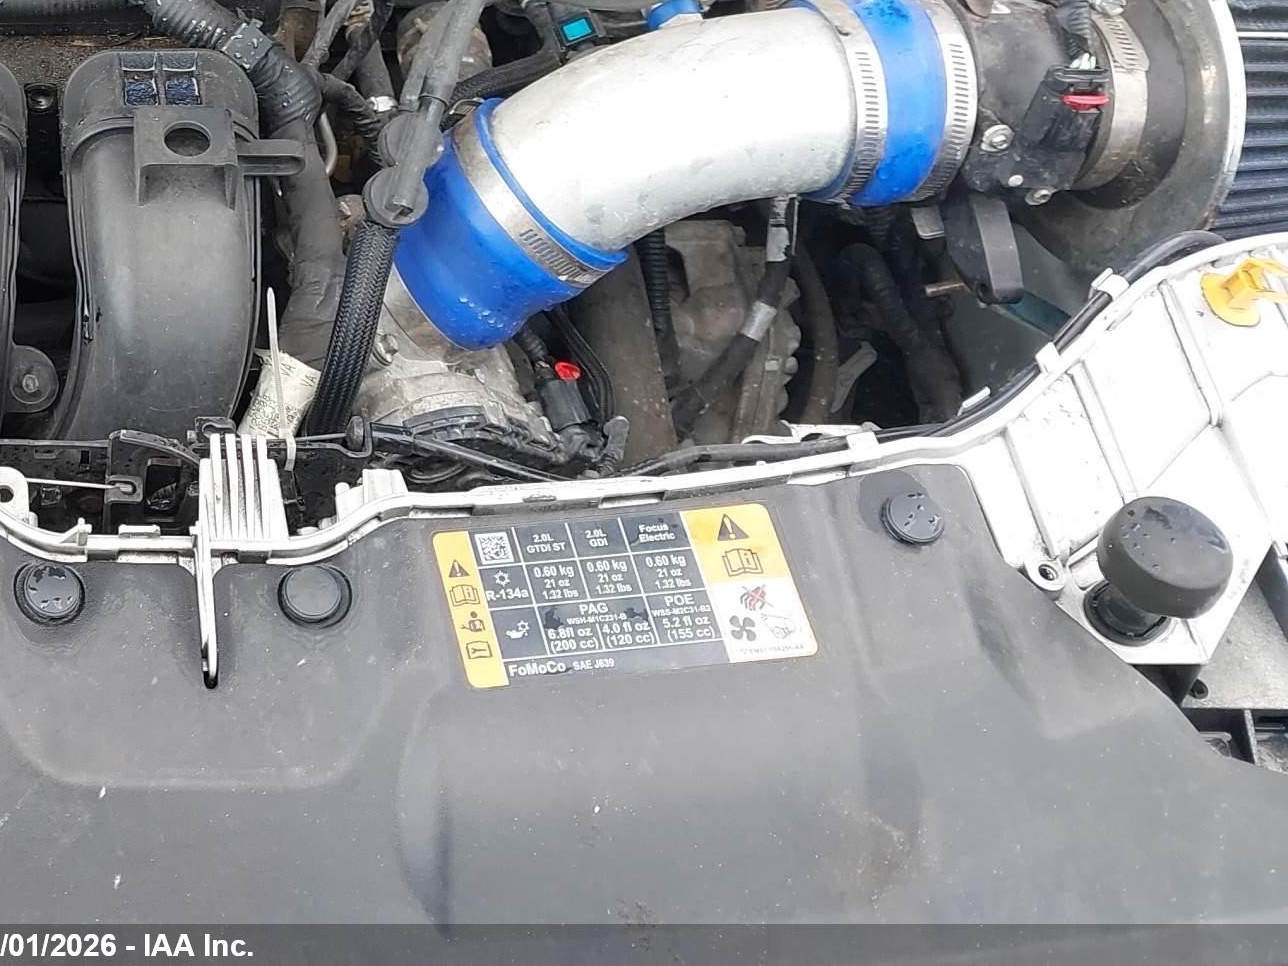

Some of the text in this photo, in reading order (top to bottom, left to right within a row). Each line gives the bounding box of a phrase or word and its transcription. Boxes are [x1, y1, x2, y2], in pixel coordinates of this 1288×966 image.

[585, 529, 606, 539] 2.0L
[638, 524, 669, 533] Focus
[532, 533, 555, 543] 2.0L
[589, 538, 609, 547] GDI
[638, 532, 676, 543] Electric
[527, 542, 566, 553] GTDI ST
[586, 559, 628, 572] 0.60 kg
[645, 554, 687, 568] 0.60 kg
[533, 564, 575, 578] 0.60 kg
[656, 568, 683, 578] 21 oz
[544, 579, 570, 588] 21 oz
[597, 573, 624, 583] 21 oz
[655, 578, 691, 589] 1.32 lbs
[485, 588, 529, 601] R-134a
[542, 588, 579, 600] 1.32 lbs
[596, 583, 632, 594] 1.32 lbs
[664, 594, 695, 606] POE
[579, 602, 609, 615] PAG
[602, 621, 650, 634] 4.0 fl oz
[662, 616, 710, 628] 5.2 fl oz
[577, 627, 593, 637] oz
[667, 626, 715, 642] (155 cc)
[550, 637, 599, 654] (200 cc)
[606, 632, 655, 648] (120 cc)
[508, 658, 615, 677] FoMoCo SAE J639
